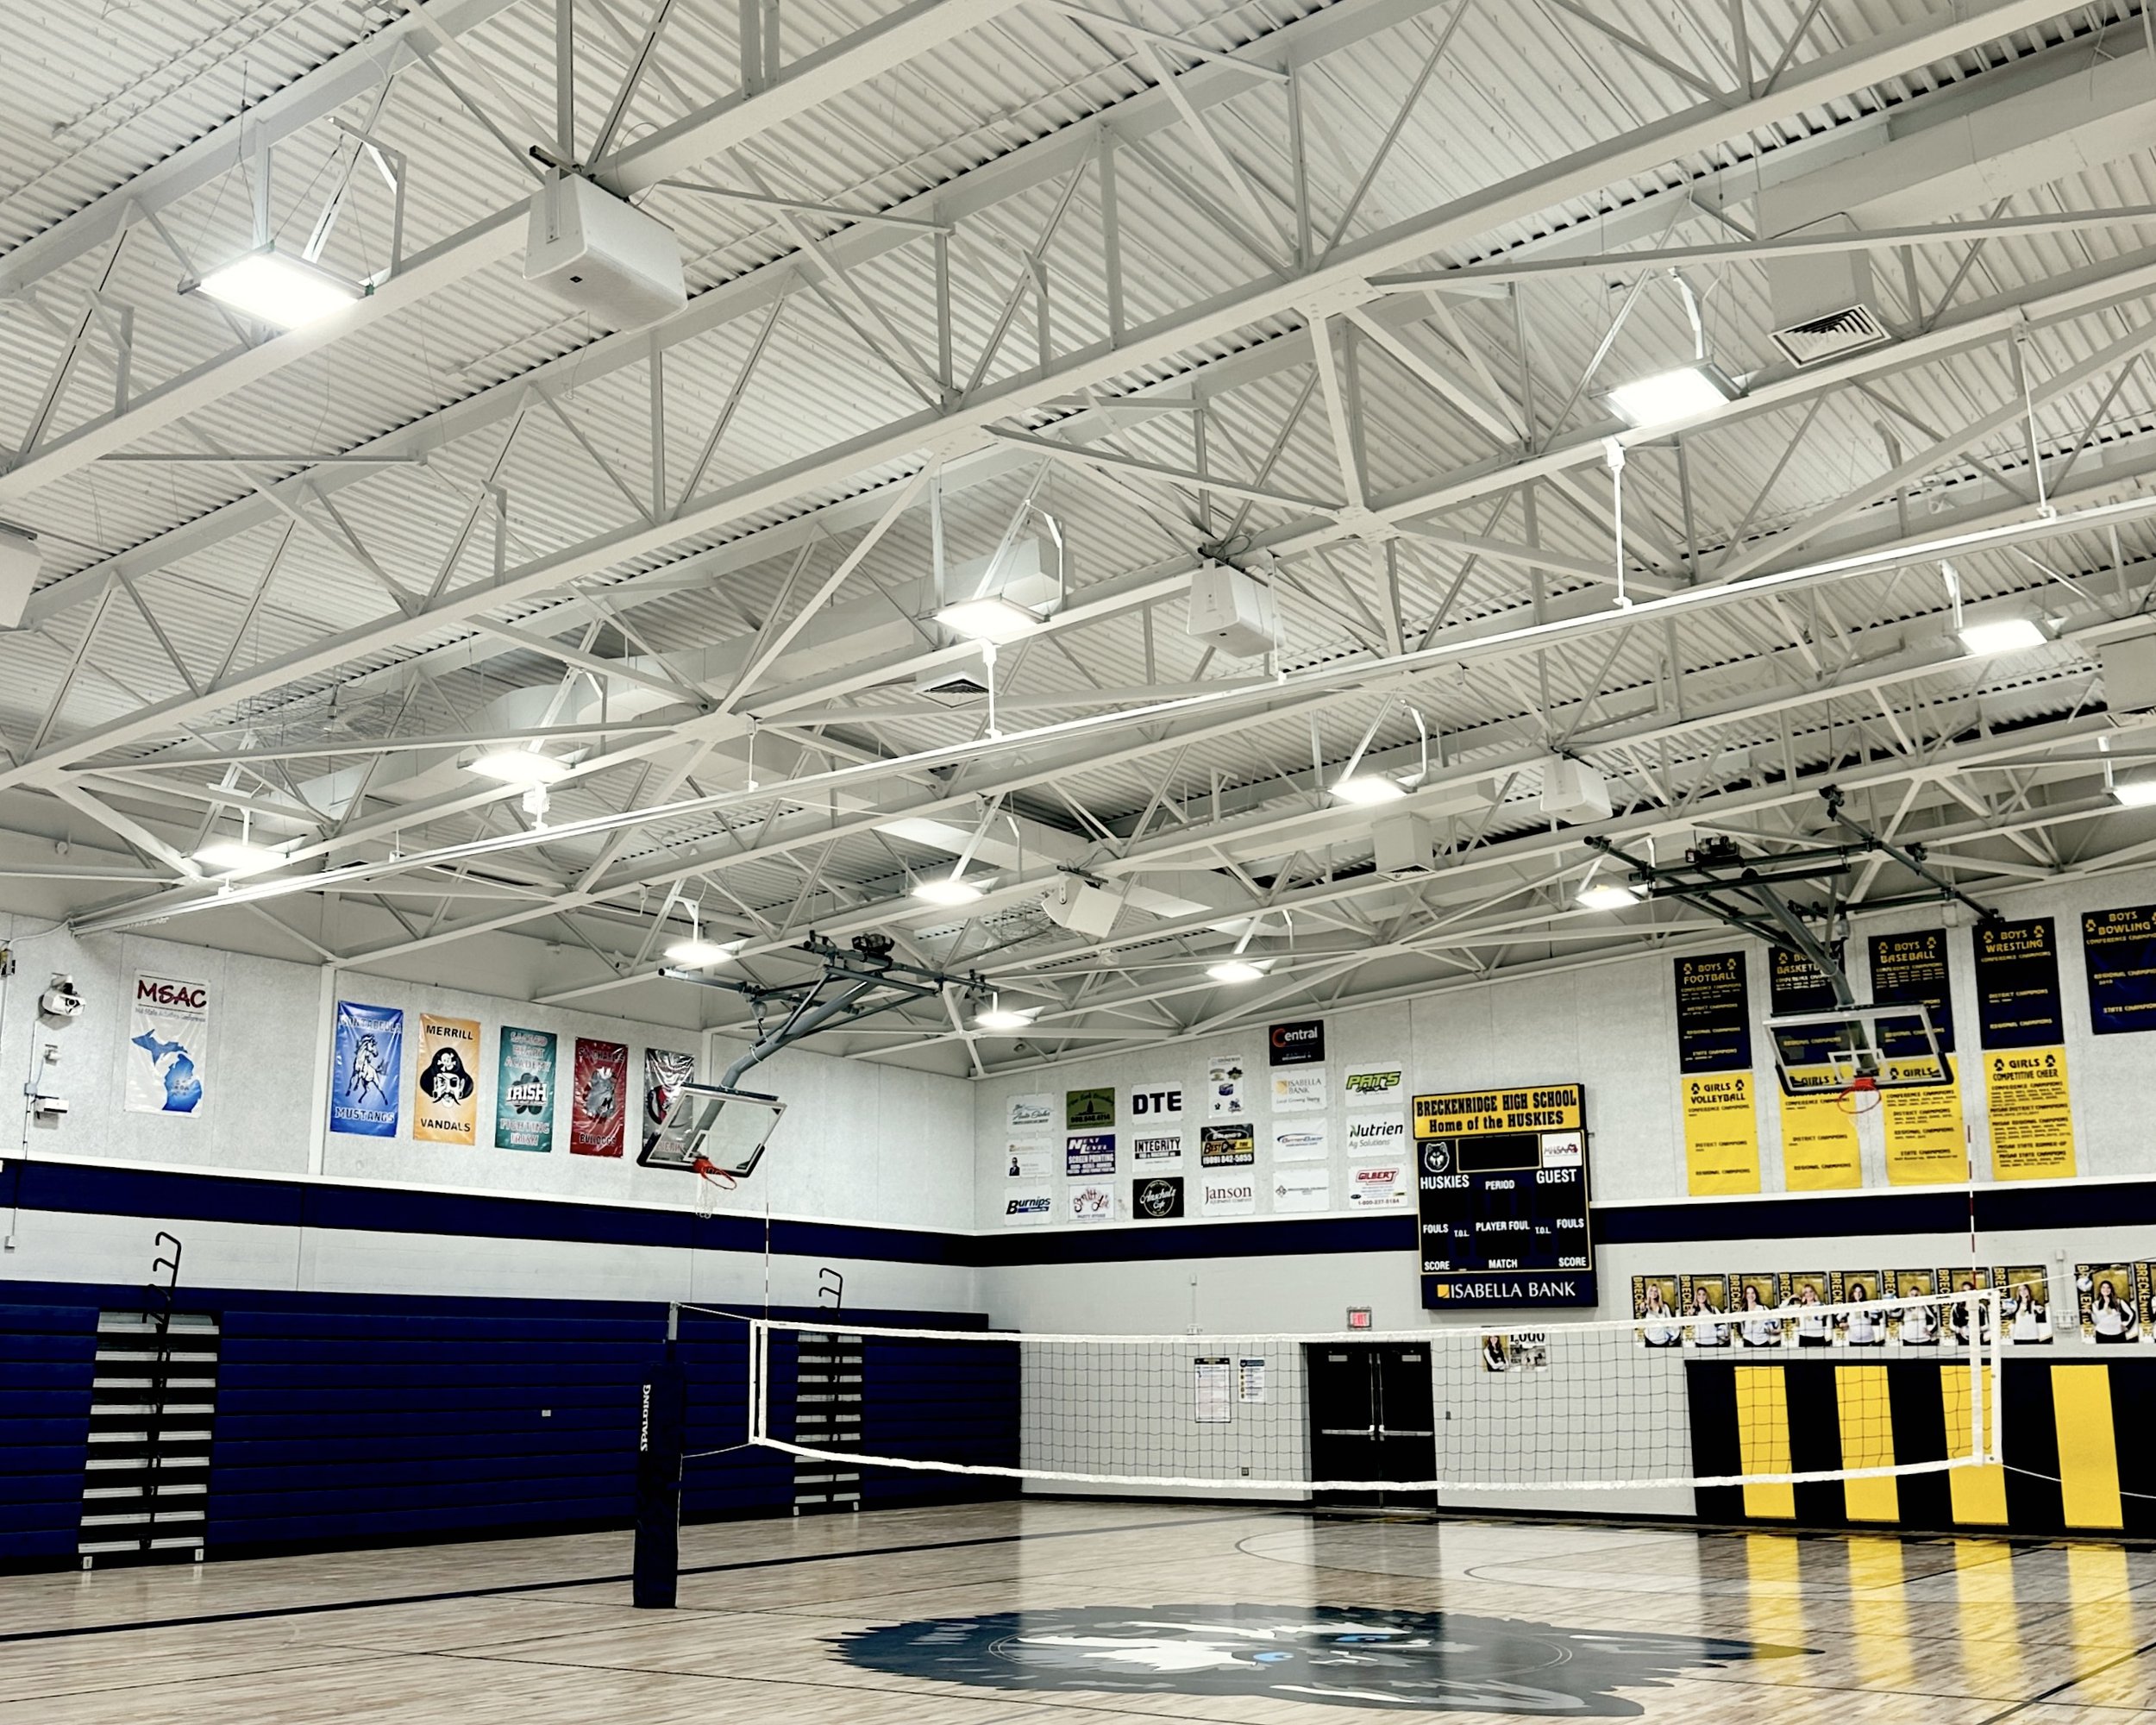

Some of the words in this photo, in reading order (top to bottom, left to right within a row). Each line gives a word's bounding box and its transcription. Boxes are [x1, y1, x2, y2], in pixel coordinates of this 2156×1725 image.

[2109, 911, 2138, 922] BOYS
[2001, 930, 2028, 940] BOYS
[2098, 921, 2151, 936] BOWLING
[1894, 941, 1920, 951] BOYS
[1986, 939, 2043, 953] WRESTLING
[1880, 950, 1935, 963] BASEBALL
[1698, 963, 1721, 972] BOYS
[1777, 963, 1821, 975] BASKETB
[1683, 972, 1736, 984] FOOTBALL
[137, 980, 207, 1008] MSAC
[426, 1025, 473, 1040] MERRILL
[1272, 1026, 1318, 1047] Central
[2009, 1058, 2040, 1069] GIRLS
[1903, 1068, 1932, 1077] GIRLS
[1993, 1070, 2034, 1081] COMPETITIVE
[2036, 1069, 2059, 1078] CHEER
[1345, 1071, 1401, 1090] PAT'S
[1703, 1082, 1731, 1092] GIRLS
[1802, 1076, 1829, 1086] GIRLS
[506, 1083, 547, 1101] IRISH
[1690, 1093, 1745, 1104] VOLLEYBALL
[1133, 1091, 1181, 1114] DTE
[1417, 1095, 1497, 1117] BRECKENRIDGE
[1502, 1093, 1528, 1111] HIGH
[1532, 1089, 1576, 1108] SCHOOL
[335, 1107, 395, 1122] MUSTANGS
[420, 1118, 471, 1132] VANDALS
[1429, 1120, 1463, 1133] Home
[1467, 1116, 1479, 1130] of
[1483, 1115, 1503, 1129] the
[1507, 1110, 1564, 1127] HUSKIES
[1350, 1122, 1403, 1138] Nutrien
[580, 1133, 617, 1146] BULLDOGS
[1134, 1138, 1181, 1152] INTEGRITY
[1359, 1138, 1390, 1148] Solutions
[1357, 1170, 1397, 1182] GILBERT
[1420, 1175, 1470, 1189] HUSKIES
[1536, 1169, 1576, 1184] GUEST
[1485, 1180, 1515, 1190] PERIOD
[1205, 1186, 1252, 1205] Janson
[1006, 1196, 1051, 1214] Burnips
[1423, 1224, 1449, 1233] FOULS
[1476, 1221, 1507, 1232] PLAYER
[1508, 1220, 1530, 1231] FOUL
[1557, 1219, 1584, 1228] FOULS
[1425, 1261, 1450, 1270] SCORE
[1489, 1258, 1518, 1269] MATCH
[1558, 1257, 1586, 1267] SCORE
[1451, 1283, 1522, 1299] ISABELLA
[1528, 1282, 1576, 1297] BANK
[641, 1384, 651, 1452] SPALDING
